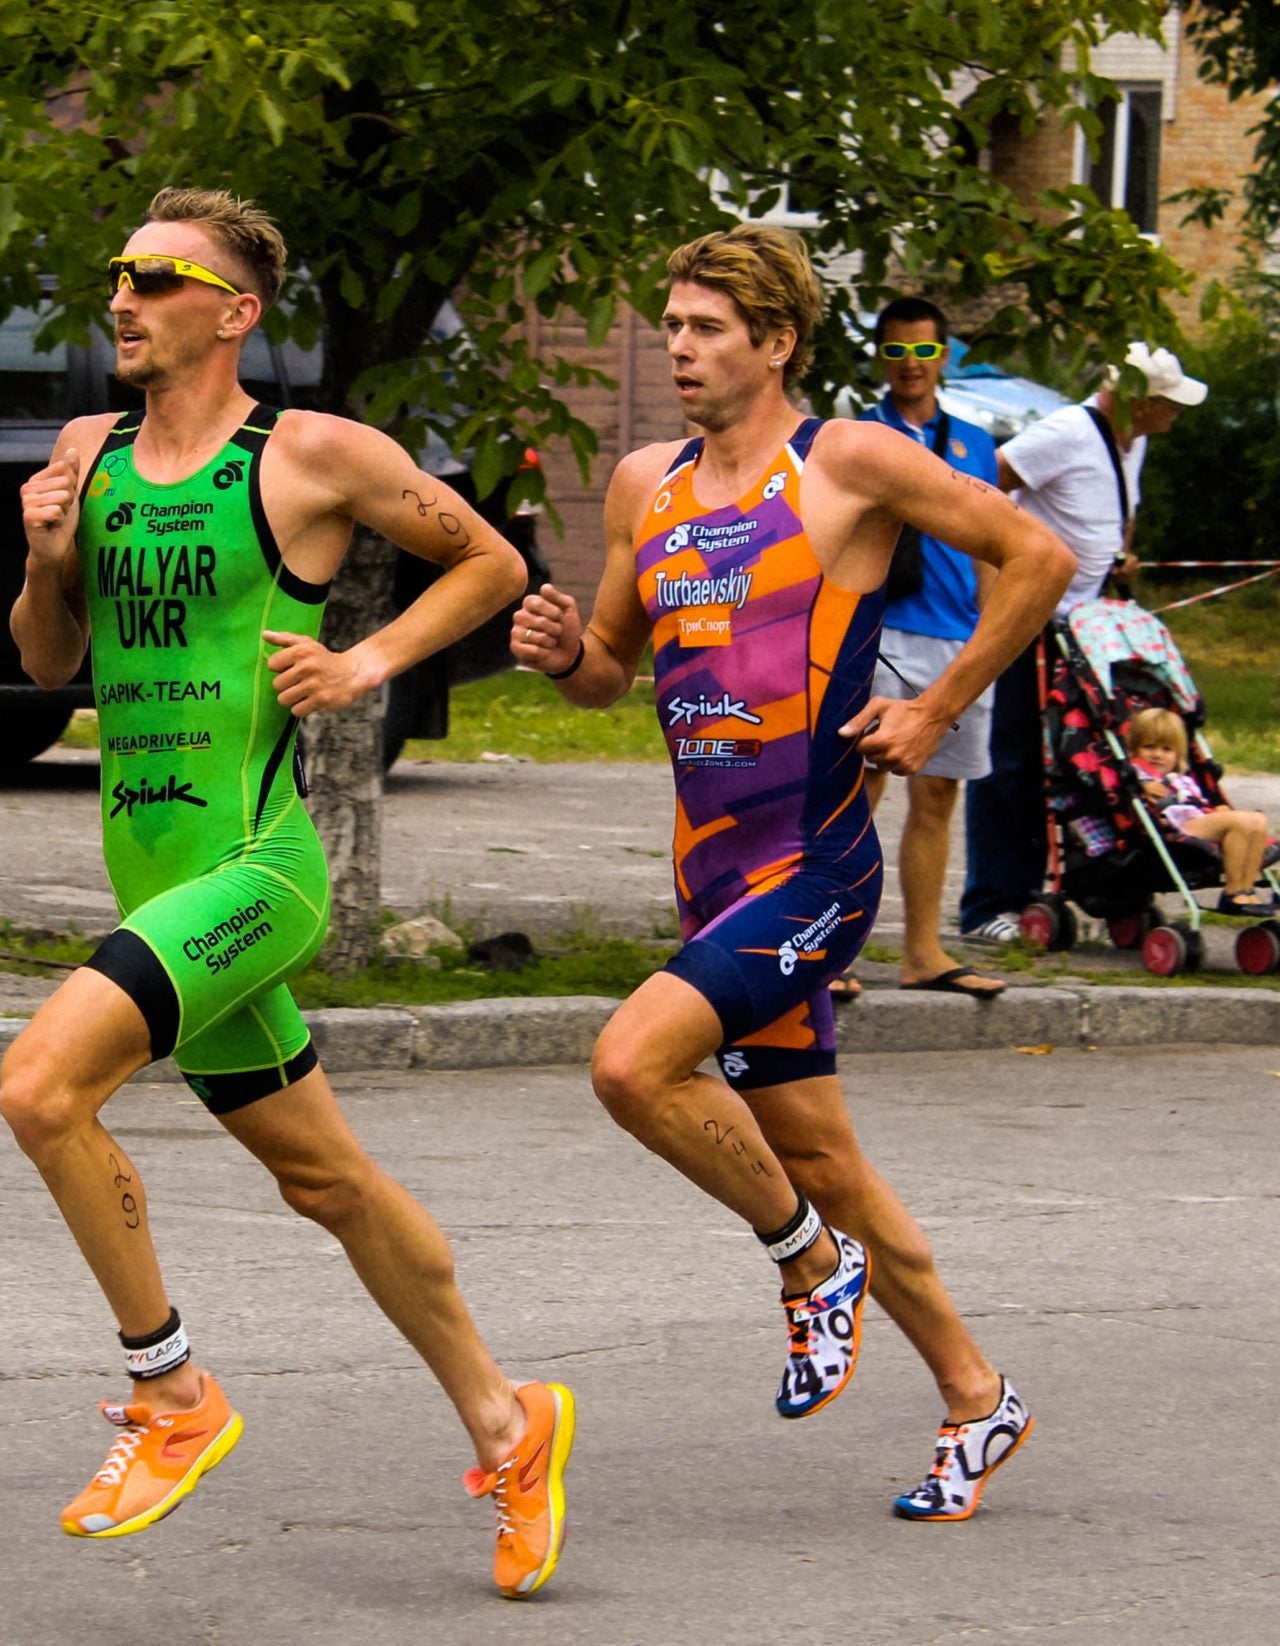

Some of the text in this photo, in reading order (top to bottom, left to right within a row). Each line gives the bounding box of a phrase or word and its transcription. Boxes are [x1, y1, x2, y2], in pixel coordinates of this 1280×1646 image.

[140, 500, 214, 518] Champion
[146, 519, 205, 536] System
[692, 520, 758, 537] Champion
[696, 534, 750, 552] System
[97, 545, 217, 598] MALYAR
[655, 565, 753, 610] Turbaevskiy
[116, 599, 189, 649] UKR
[678, 617, 731, 636] ТриСпорт
[100, 680, 221, 705] SAPIK-TEAM
[108, 731, 212, 752] MEGADRIVE.UA
[182, 898, 272, 962] Champion
[791, 901, 841, 948] Champion
[803, 915, 842, 955] System
[205, 921, 273, 976] System
[703, 1119, 773, 1178] 244
